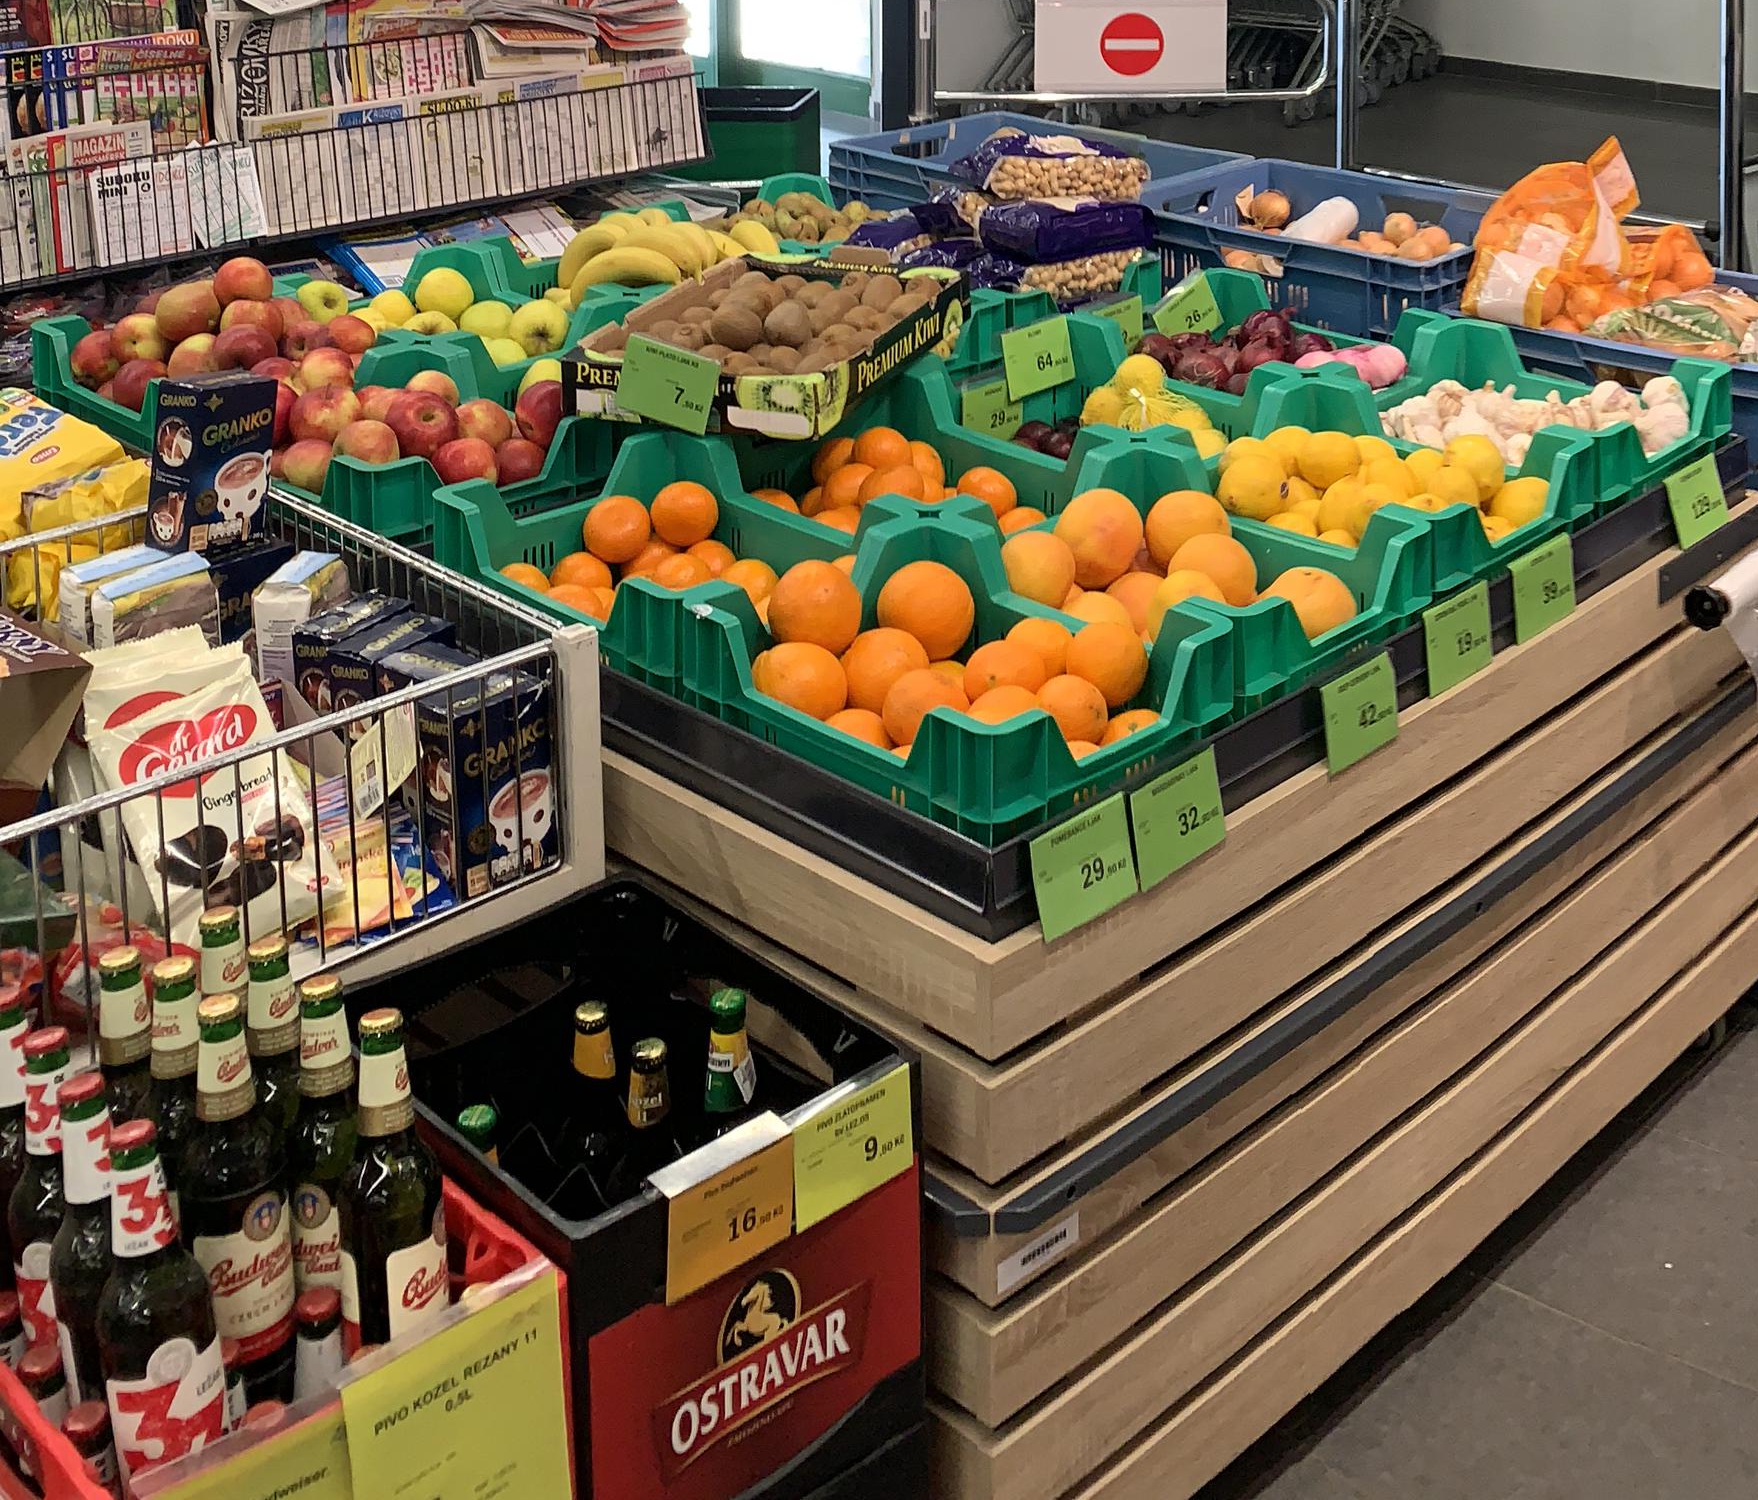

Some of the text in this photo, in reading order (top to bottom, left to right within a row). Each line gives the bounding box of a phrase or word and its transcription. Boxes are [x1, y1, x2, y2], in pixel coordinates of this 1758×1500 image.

[96, 170, 151, 188] SUDOKU
[857, 311, 941, 393] PREMIUM KIWI
[160, 394, 197, 408] GRANKO
[202, 407, 272, 446] GRANKO
[365, 617, 425, 653] GRANKO
[331, 663, 369, 682] GRANKO
[203, 767, 274, 811] Gingebread
[373, 1326, 538, 1437] PIVO KOZEL REZANY 11
[671, 1307, 850, 1456] OSTRAVAR
